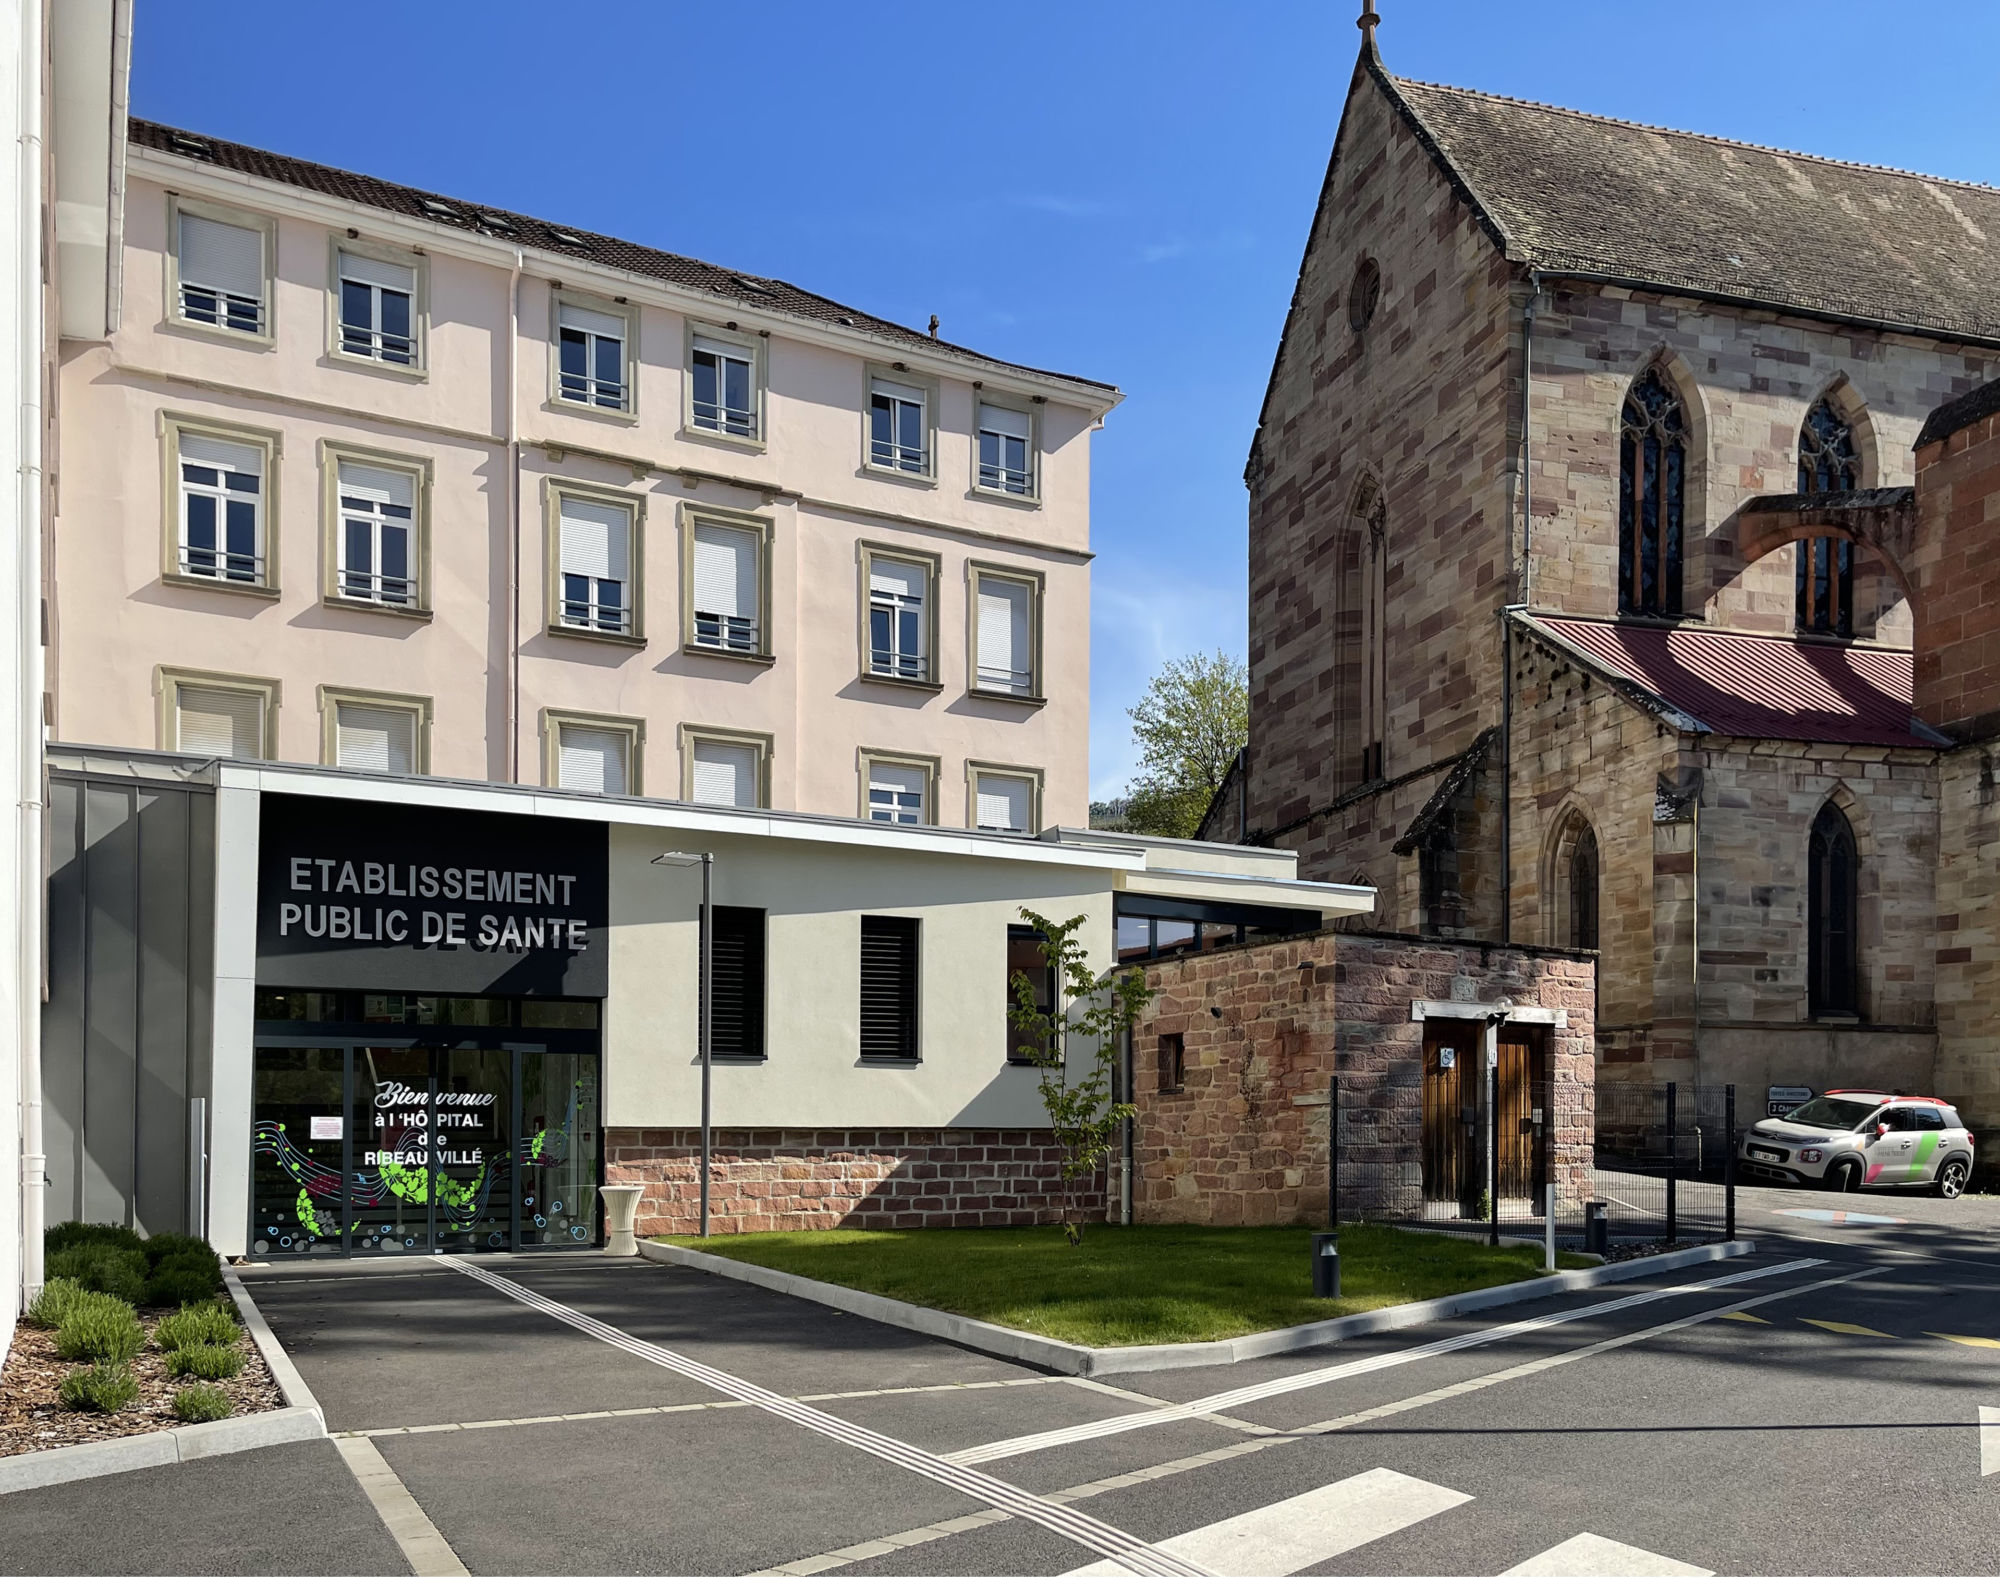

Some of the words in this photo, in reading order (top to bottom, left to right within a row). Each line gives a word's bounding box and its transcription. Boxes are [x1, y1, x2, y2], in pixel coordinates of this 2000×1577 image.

[290, 857, 577, 906] ETABLISSEMENT
[280, 902, 409, 942] PUBLIC
[422, 910, 467, 945] DE
[478, 914, 588, 951] SANTE
